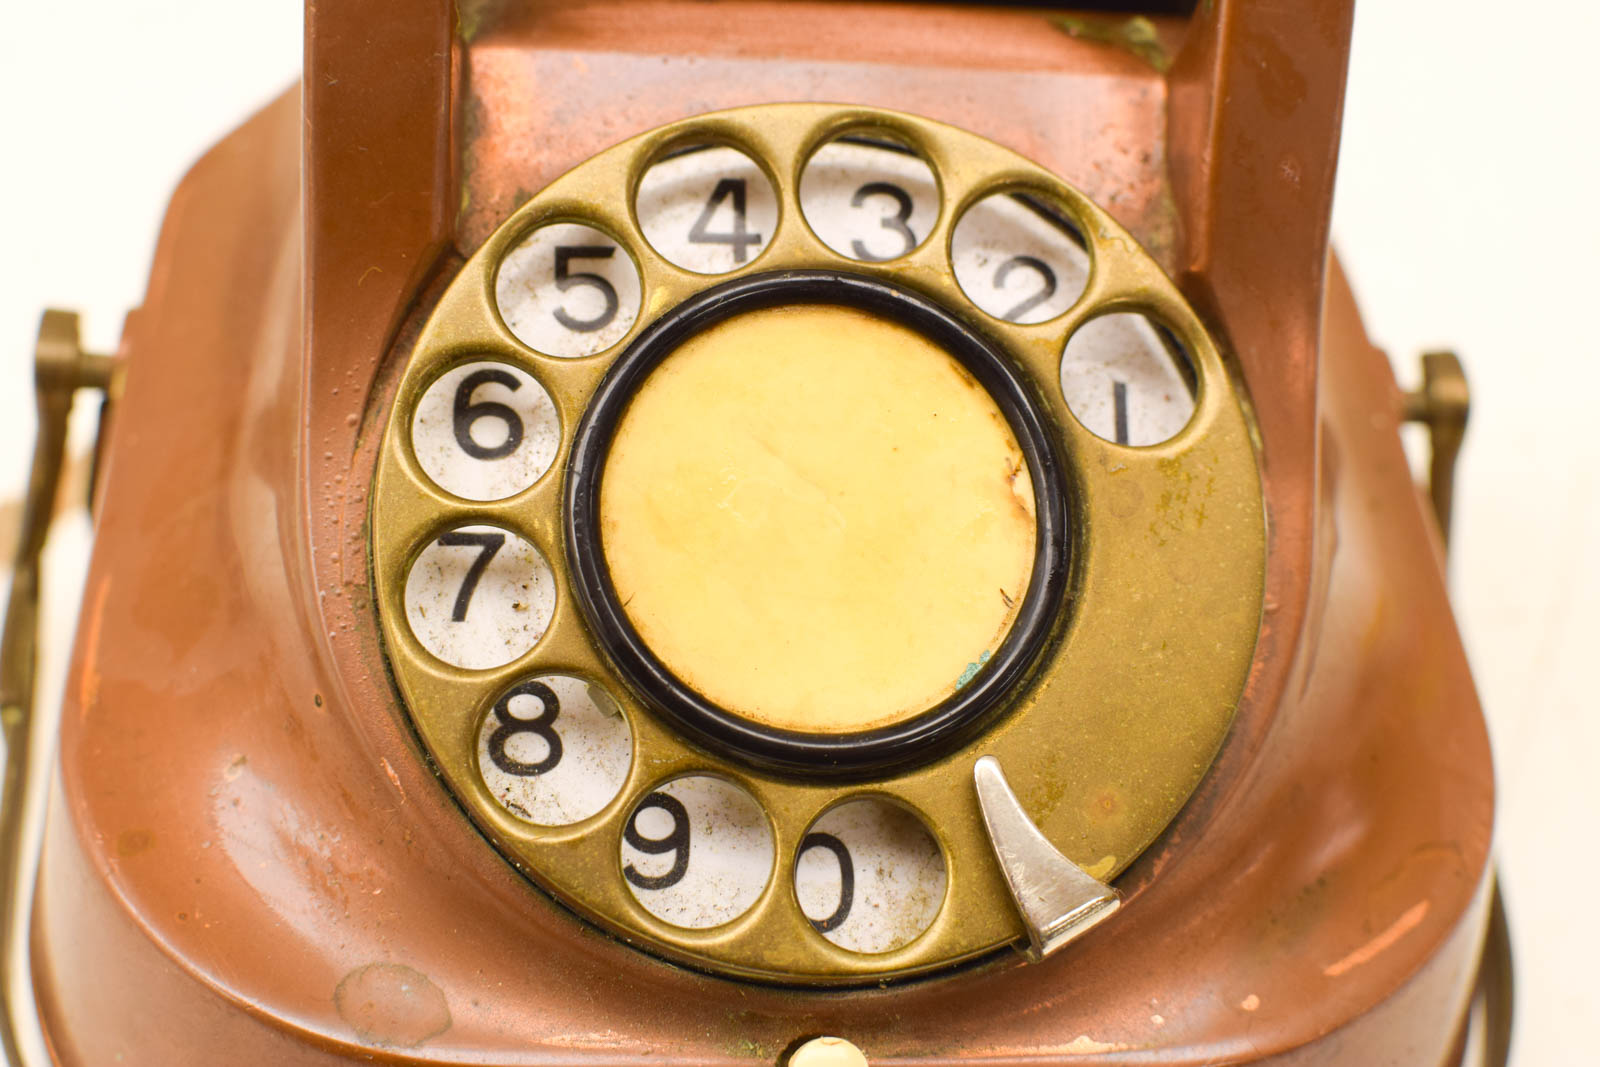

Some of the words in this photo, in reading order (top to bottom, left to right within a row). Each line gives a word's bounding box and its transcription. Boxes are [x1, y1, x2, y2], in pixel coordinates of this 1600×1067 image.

[688, 178, 762, 262] 4
[851, 182, 916, 258] 3
[553, 246, 618, 332] 5
[994, 256, 1056, 320] 2
[454, 369, 524, 459] 6
[1113, 381, 1130, 446] 1
[438, 533, 505, 622] 7
[489, 682, 563, 776] 8
[624, 793, 691, 890] 9
[797, 833, 854, 933] 0
